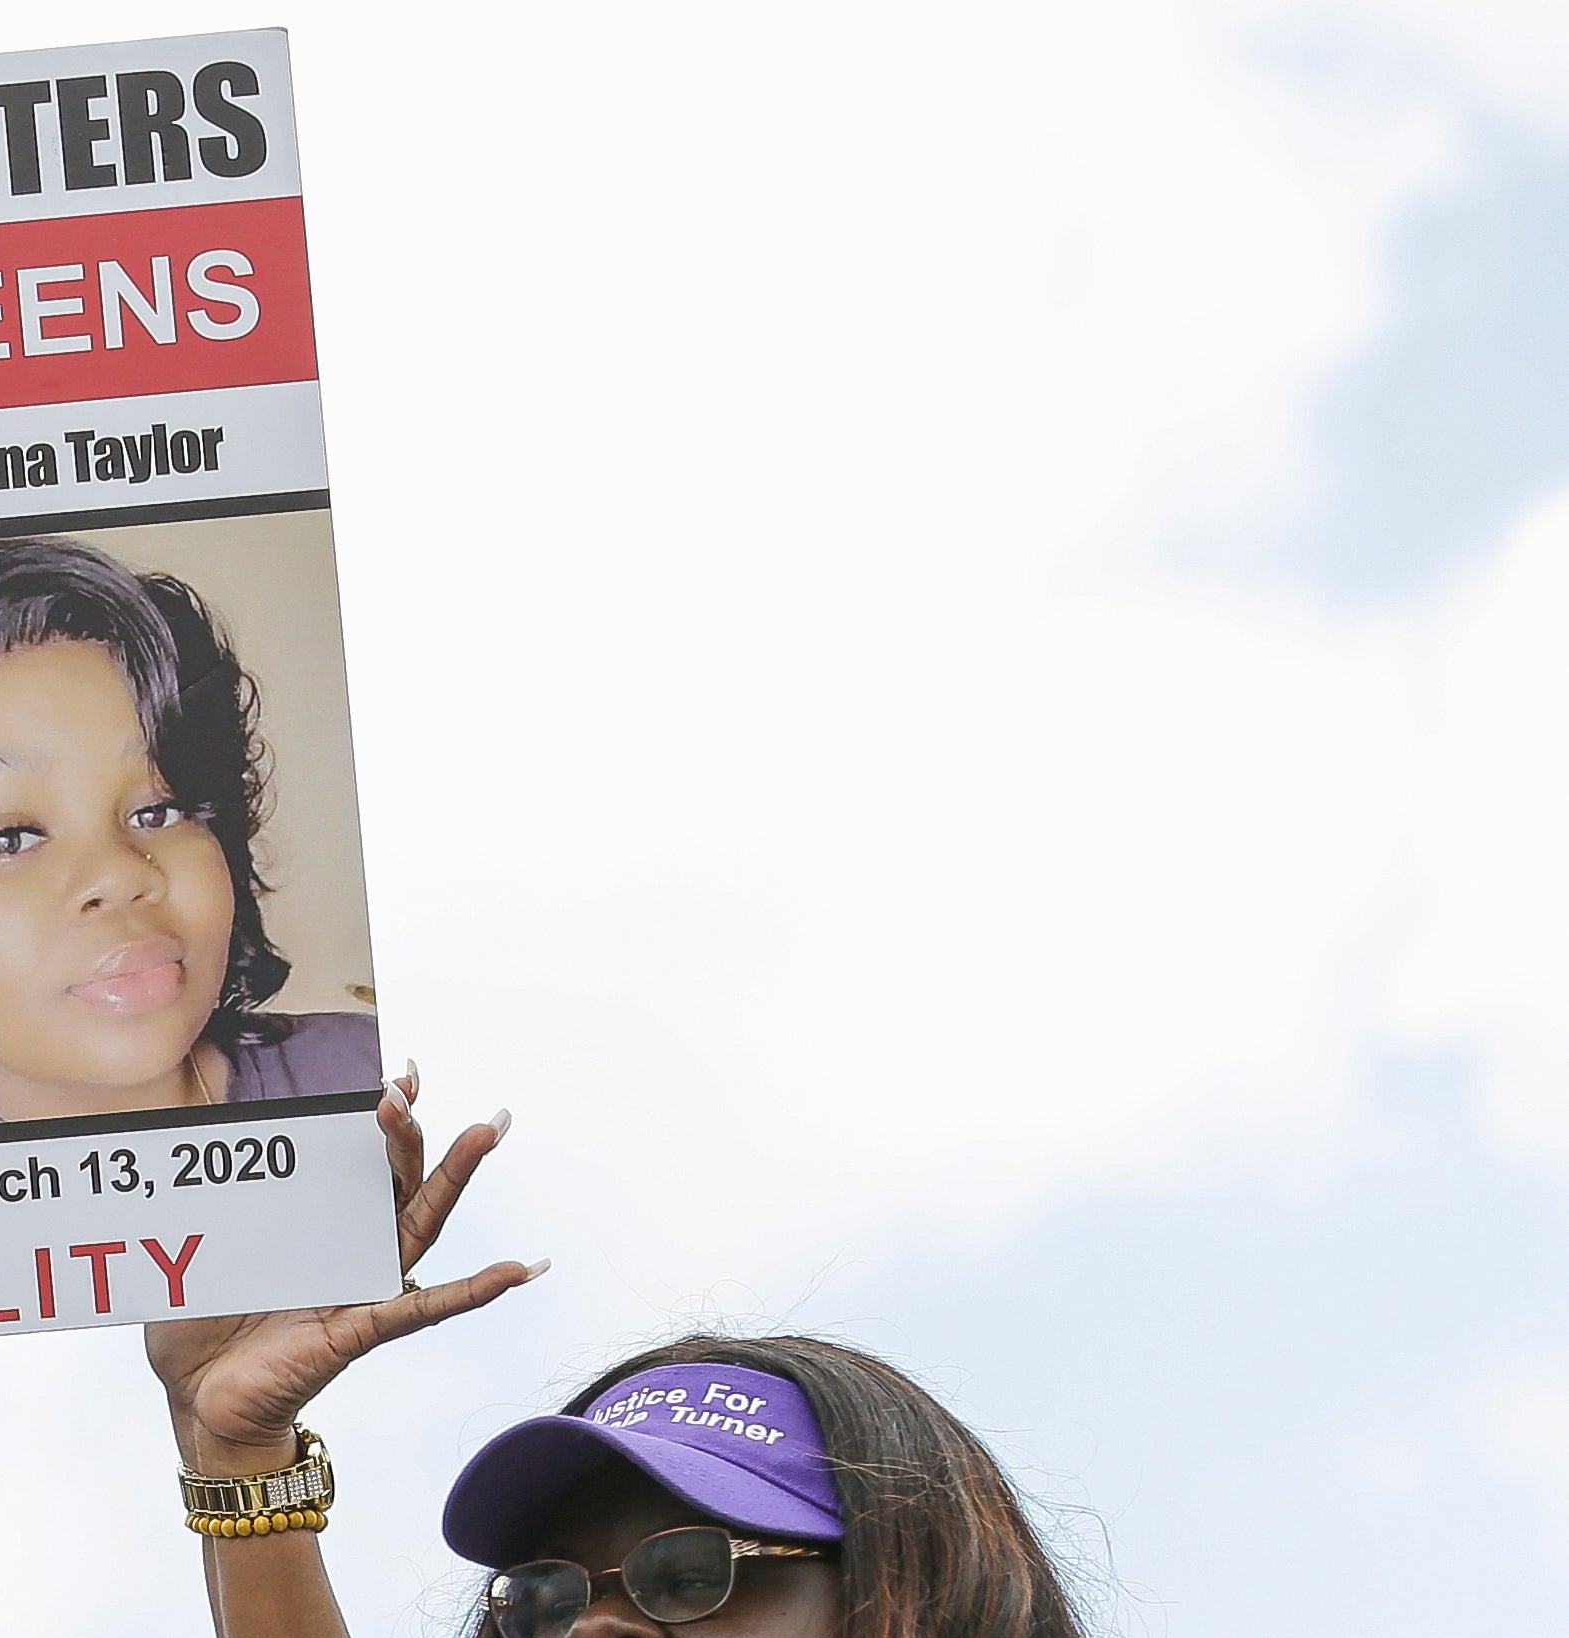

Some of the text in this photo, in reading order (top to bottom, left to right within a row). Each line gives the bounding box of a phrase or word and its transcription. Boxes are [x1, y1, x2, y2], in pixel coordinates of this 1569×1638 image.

[64, 422, 224, 485] Taylor
[78, 1148, 155, 1200] 13,
[170, 1134, 297, 1188] 2020
[592, 1382, 767, 1425] ustice For
[670, 1406, 784, 1445] Turner
